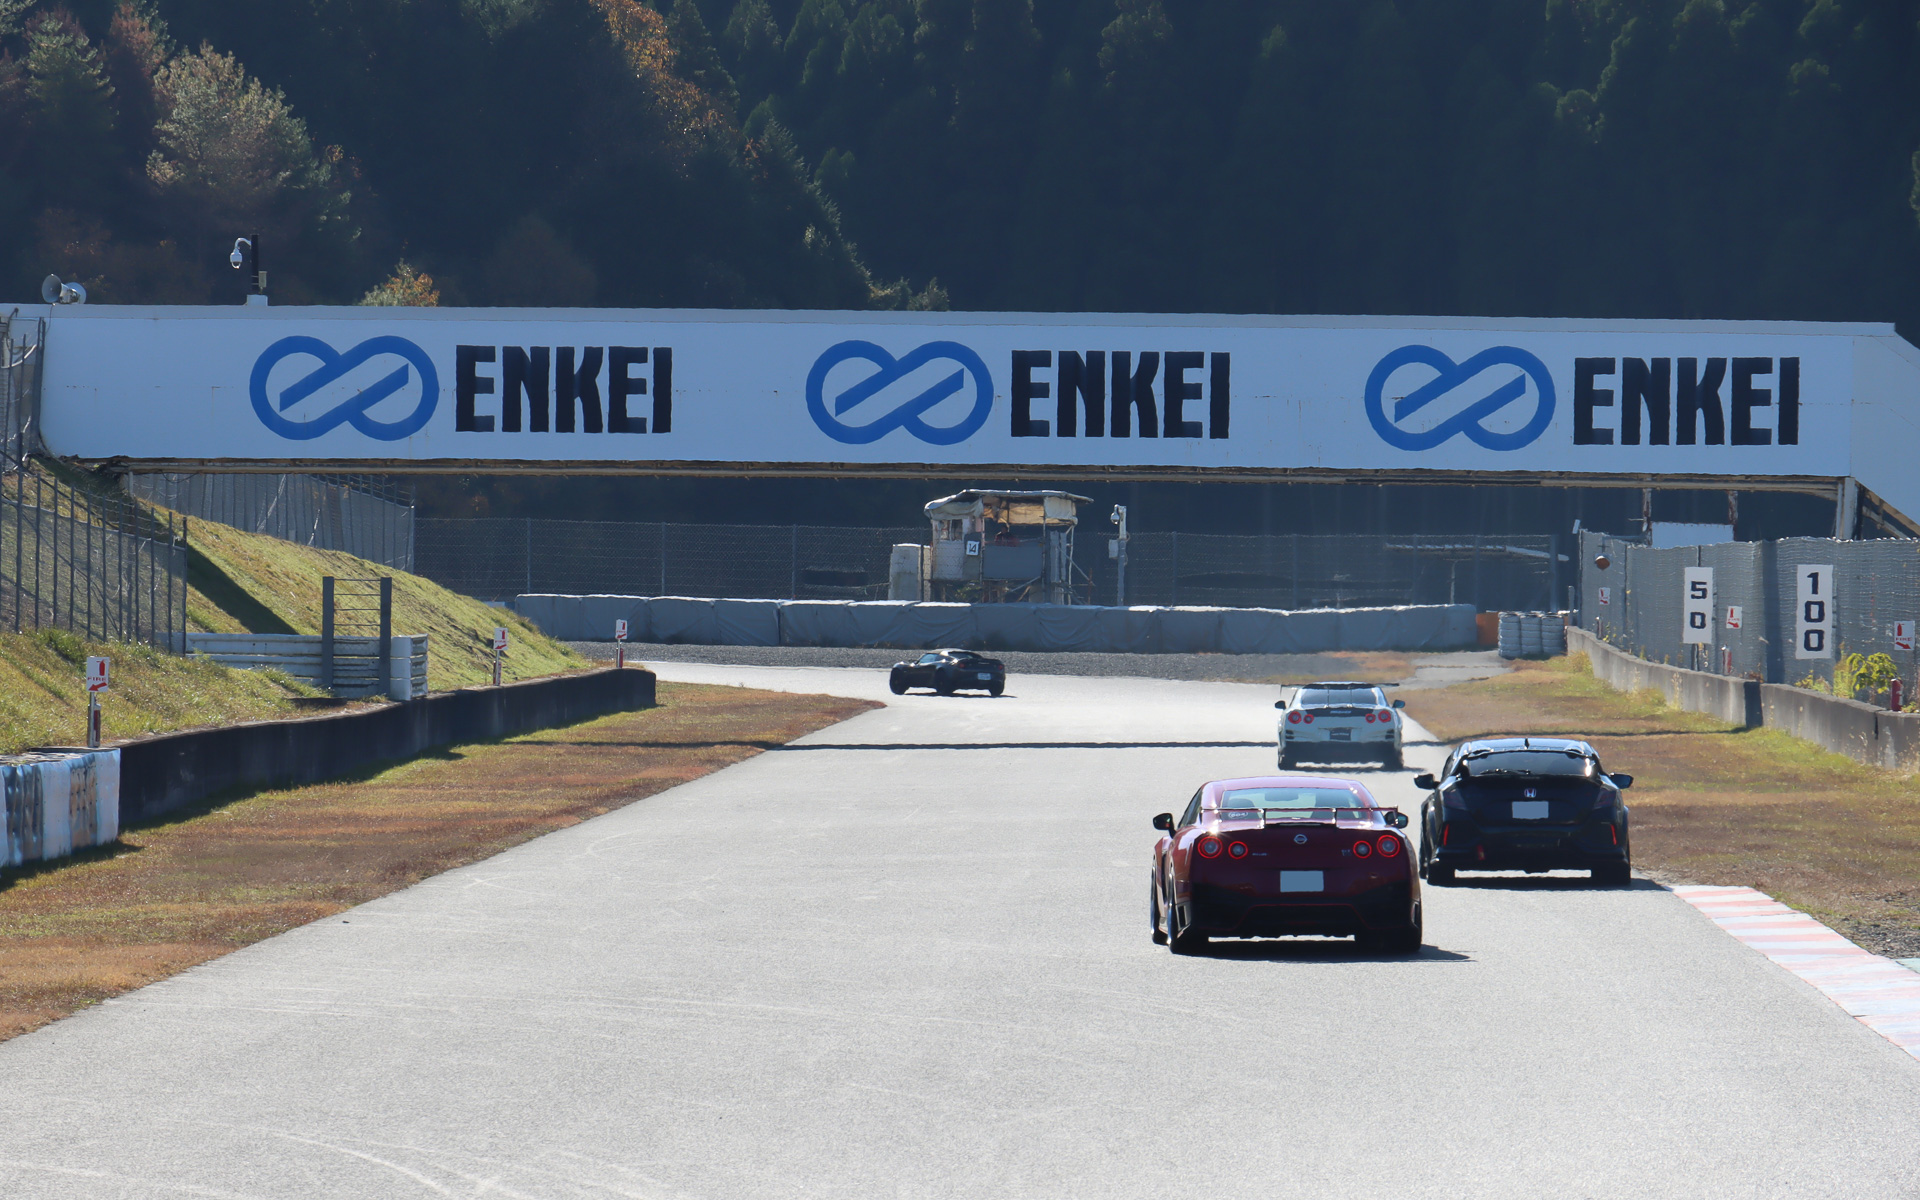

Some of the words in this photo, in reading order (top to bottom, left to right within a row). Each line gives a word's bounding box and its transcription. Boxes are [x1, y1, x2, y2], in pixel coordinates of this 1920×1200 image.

[456, 345, 672, 433] ENKEI
[1011, 350, 1230, 439] ENKEI
[1574, 357, 1802, 445] ENKEI
[1690, 580, 1708, 629] 50
[1804, 571, 1825, 652] 100
